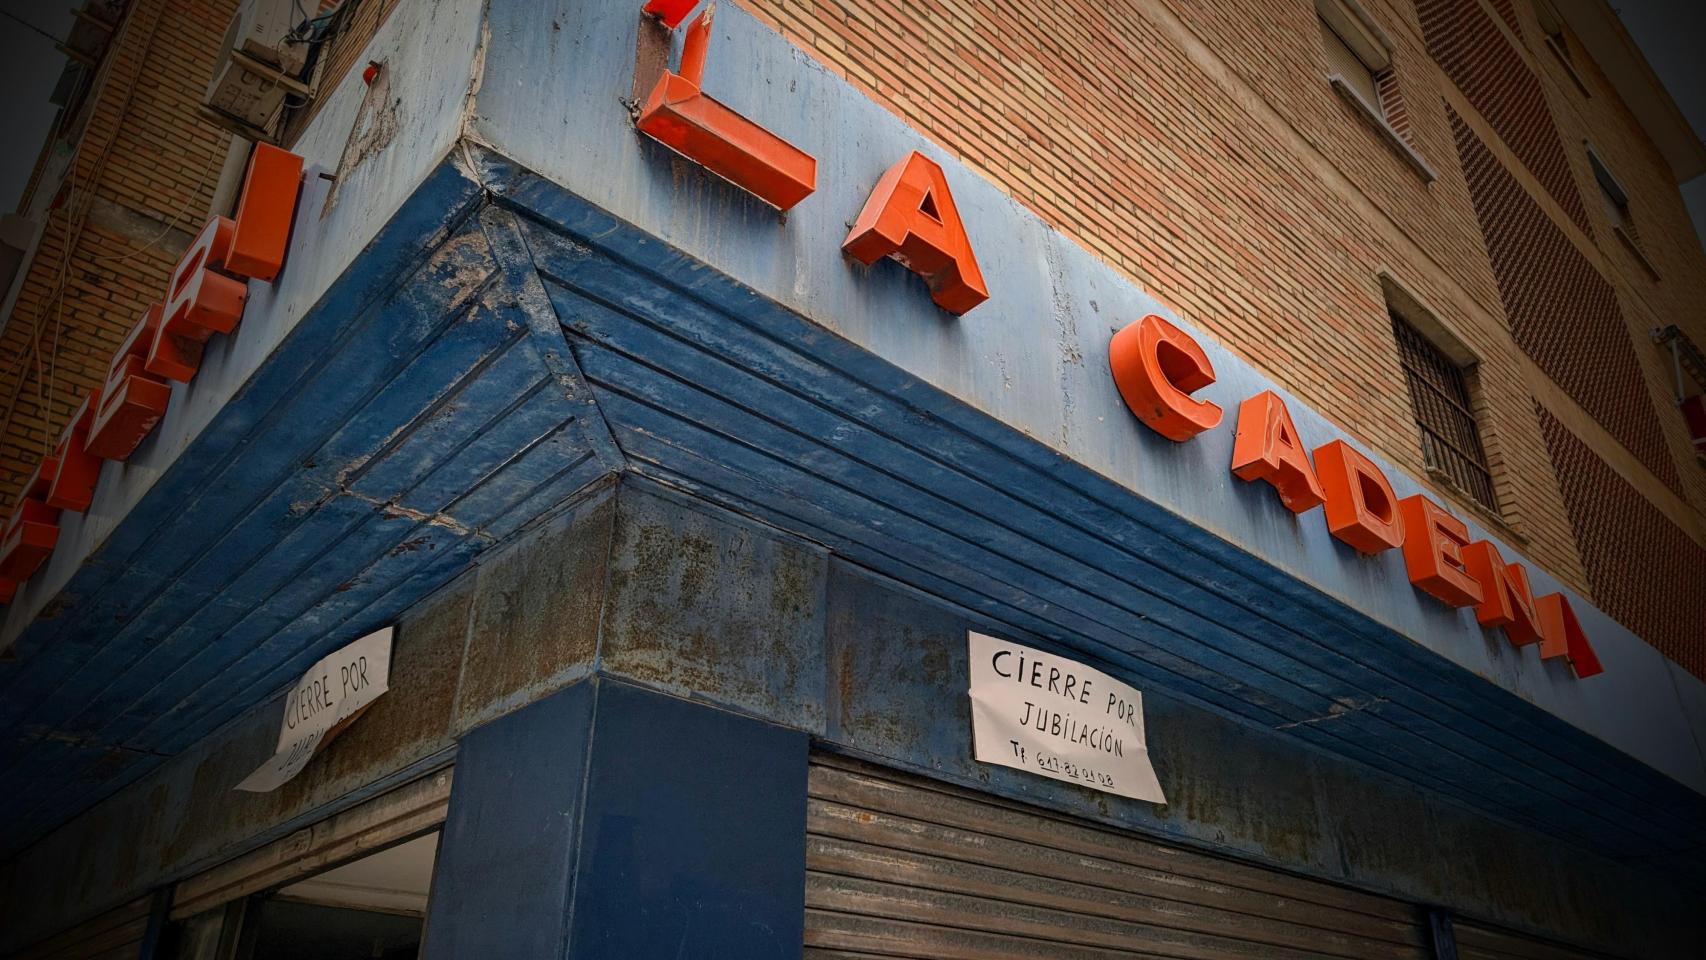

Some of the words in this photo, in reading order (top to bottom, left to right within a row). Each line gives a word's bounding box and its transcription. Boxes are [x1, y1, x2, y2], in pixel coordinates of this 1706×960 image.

[636, 0, 990, 318] LA
[1108, 313, 1604, 679] CADENA
[286, 675, 334, 729] CIERRE
[341, 656, 369, 698] POR
[992, 650, 1092, 704] CIERRE
[1106, 692, 1135, 727] POR
[1019, 701, 1123, 758] JUBILACIÓN
